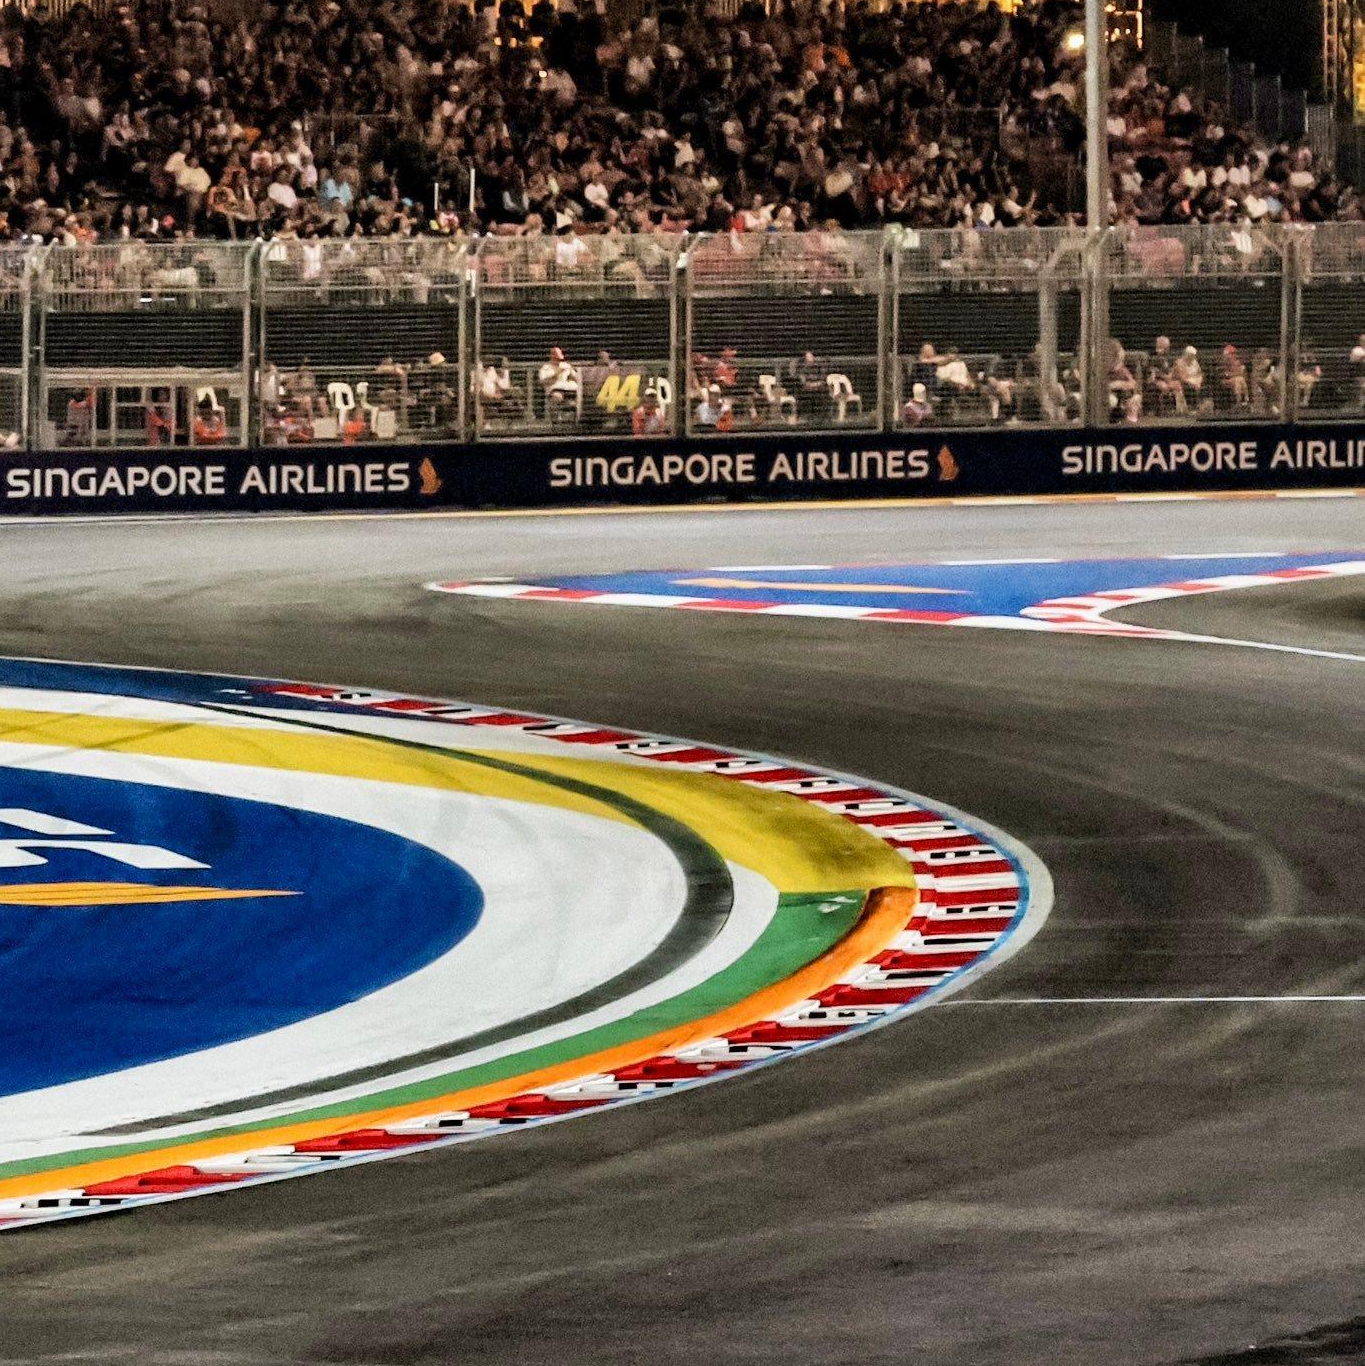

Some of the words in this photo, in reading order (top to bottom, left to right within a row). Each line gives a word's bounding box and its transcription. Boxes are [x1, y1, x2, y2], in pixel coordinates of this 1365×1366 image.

[550, 453, 755, 487] SINGAPORE
[769, 449, 929, 480] AIRLINES
[1062, 442, 1258, 474] SINGAPORE
[6, 464, 225, 498] SINGAPORE
[240, 462, 409, 493] AIRLINES
